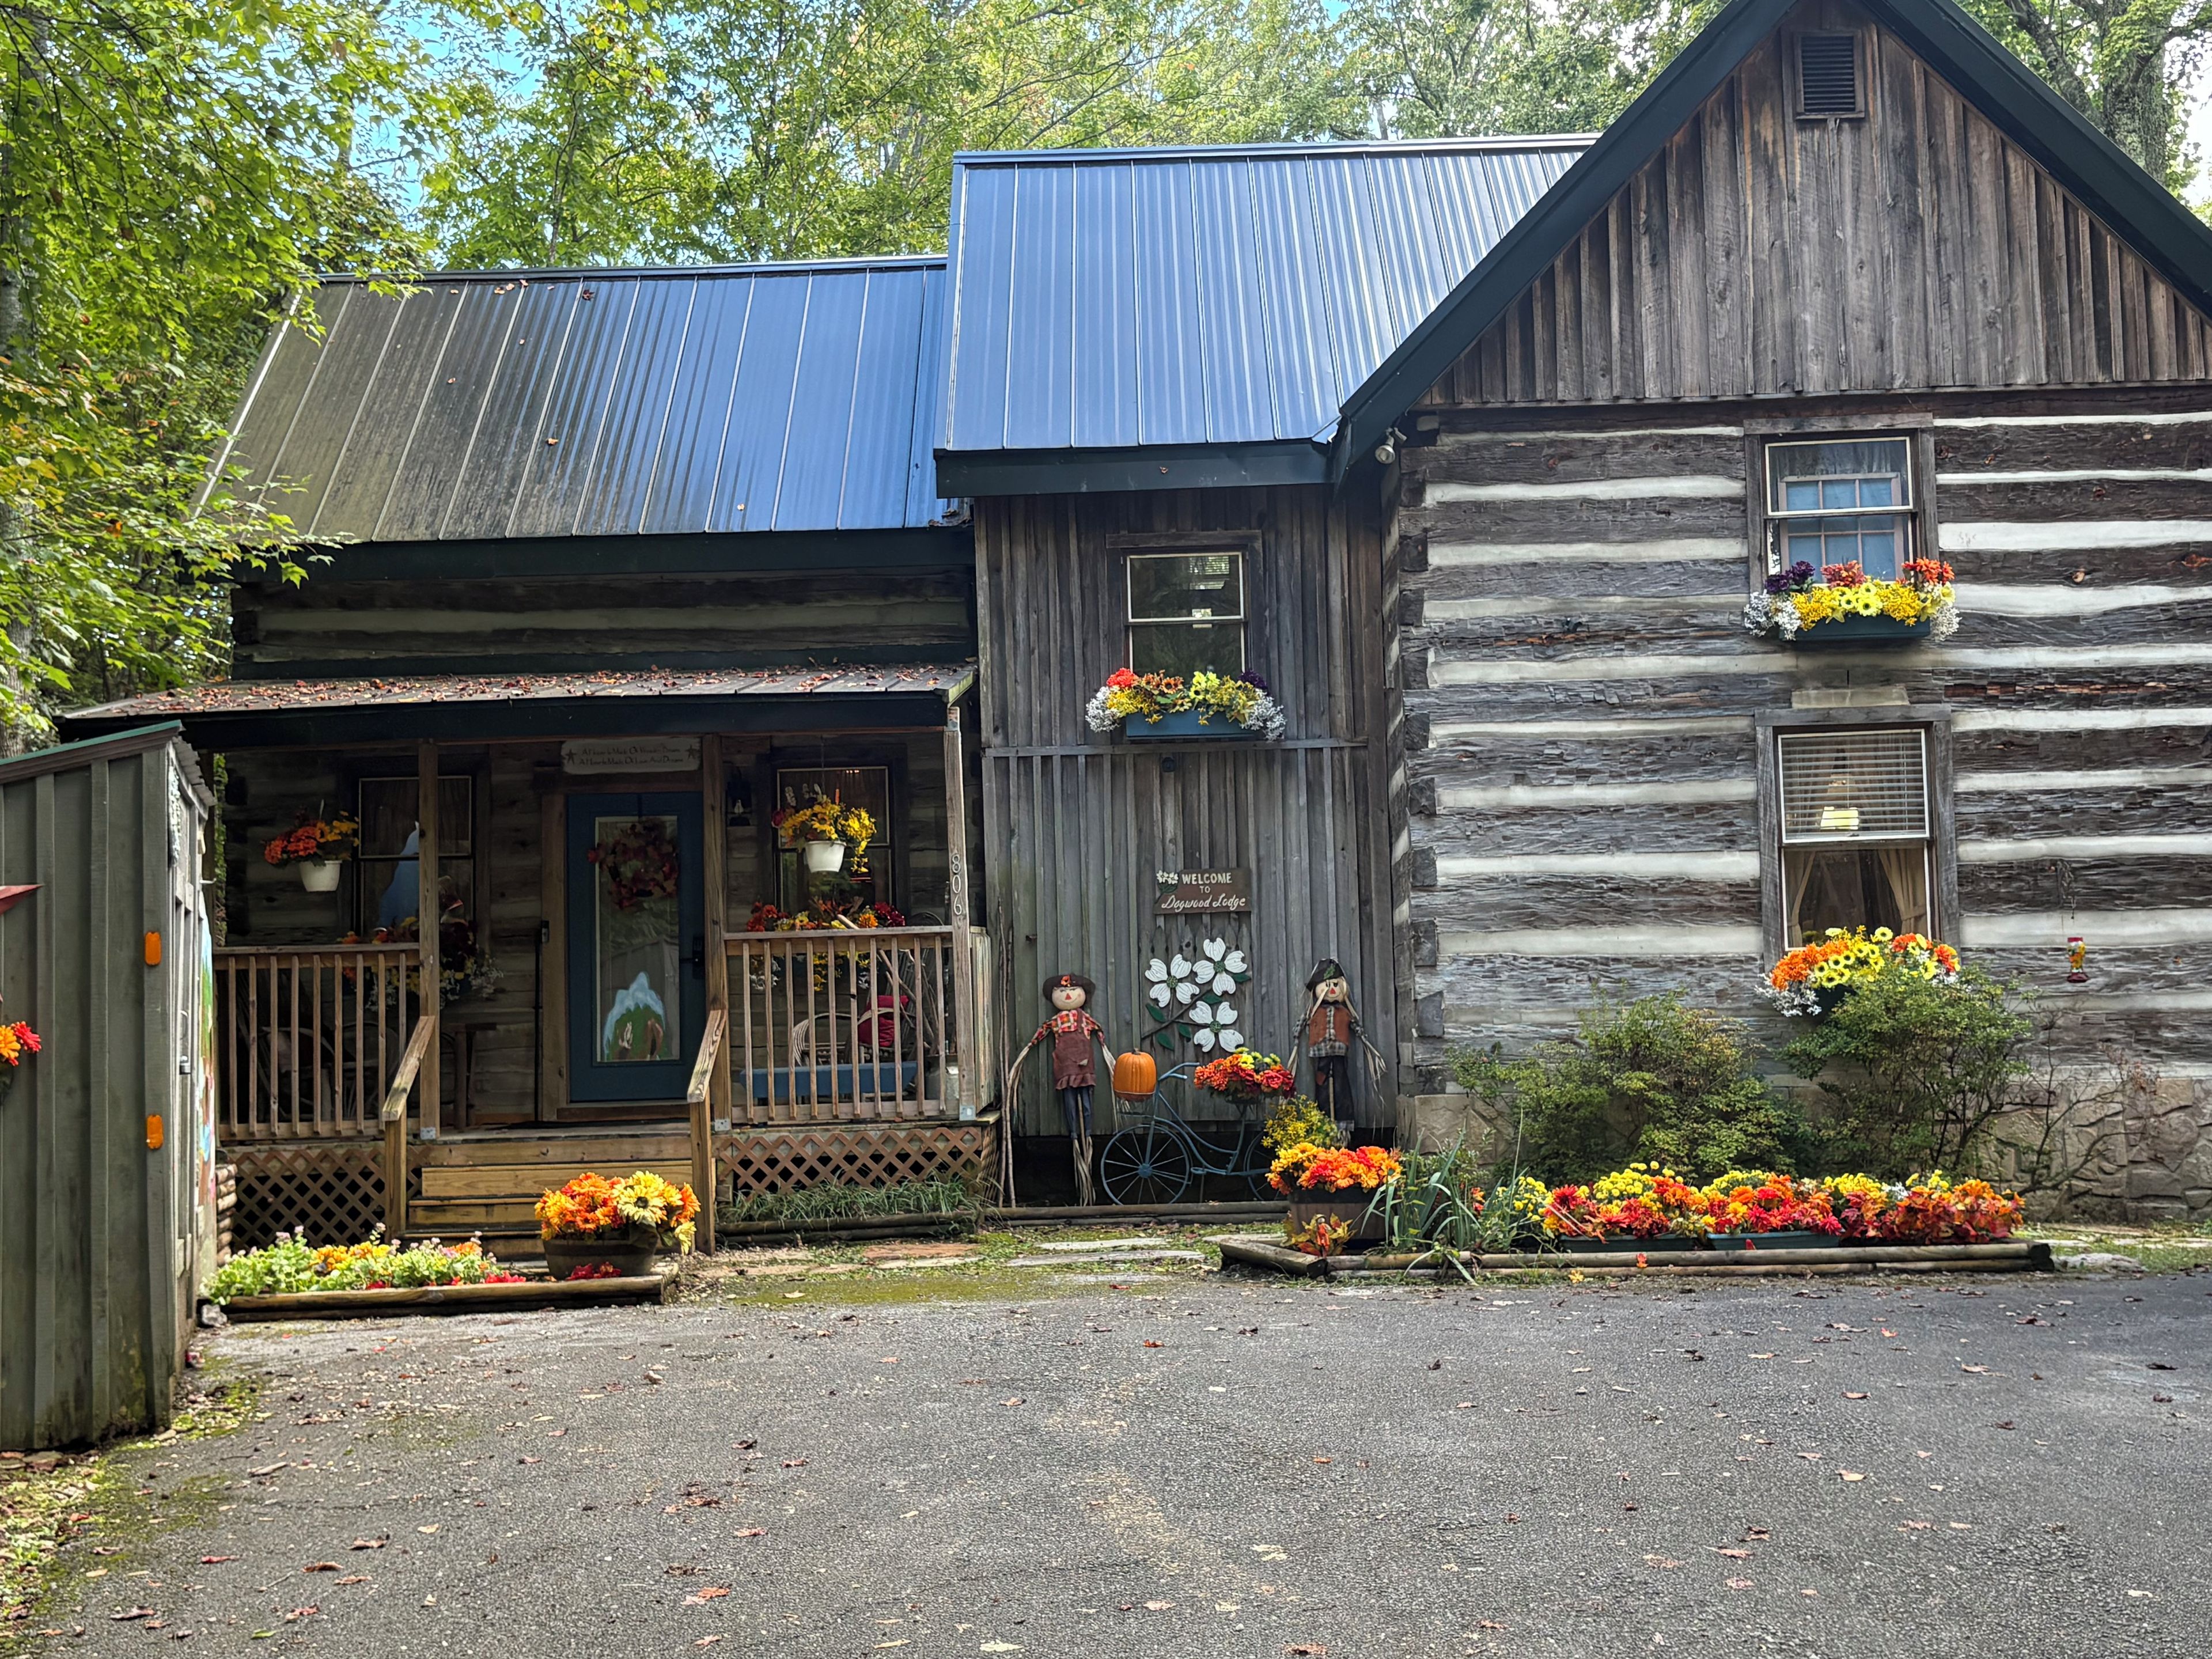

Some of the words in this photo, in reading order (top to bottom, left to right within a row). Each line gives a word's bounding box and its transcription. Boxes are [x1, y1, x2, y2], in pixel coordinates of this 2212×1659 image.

[952, 854, 962, 915] 806
[1181, 872, 1233, 885] WELCOME
[1199, 885, 1210, 893] TO
[1161, 895, 1213, 912] Dogwood
[1212, 893, 1246, 911] Lodge
